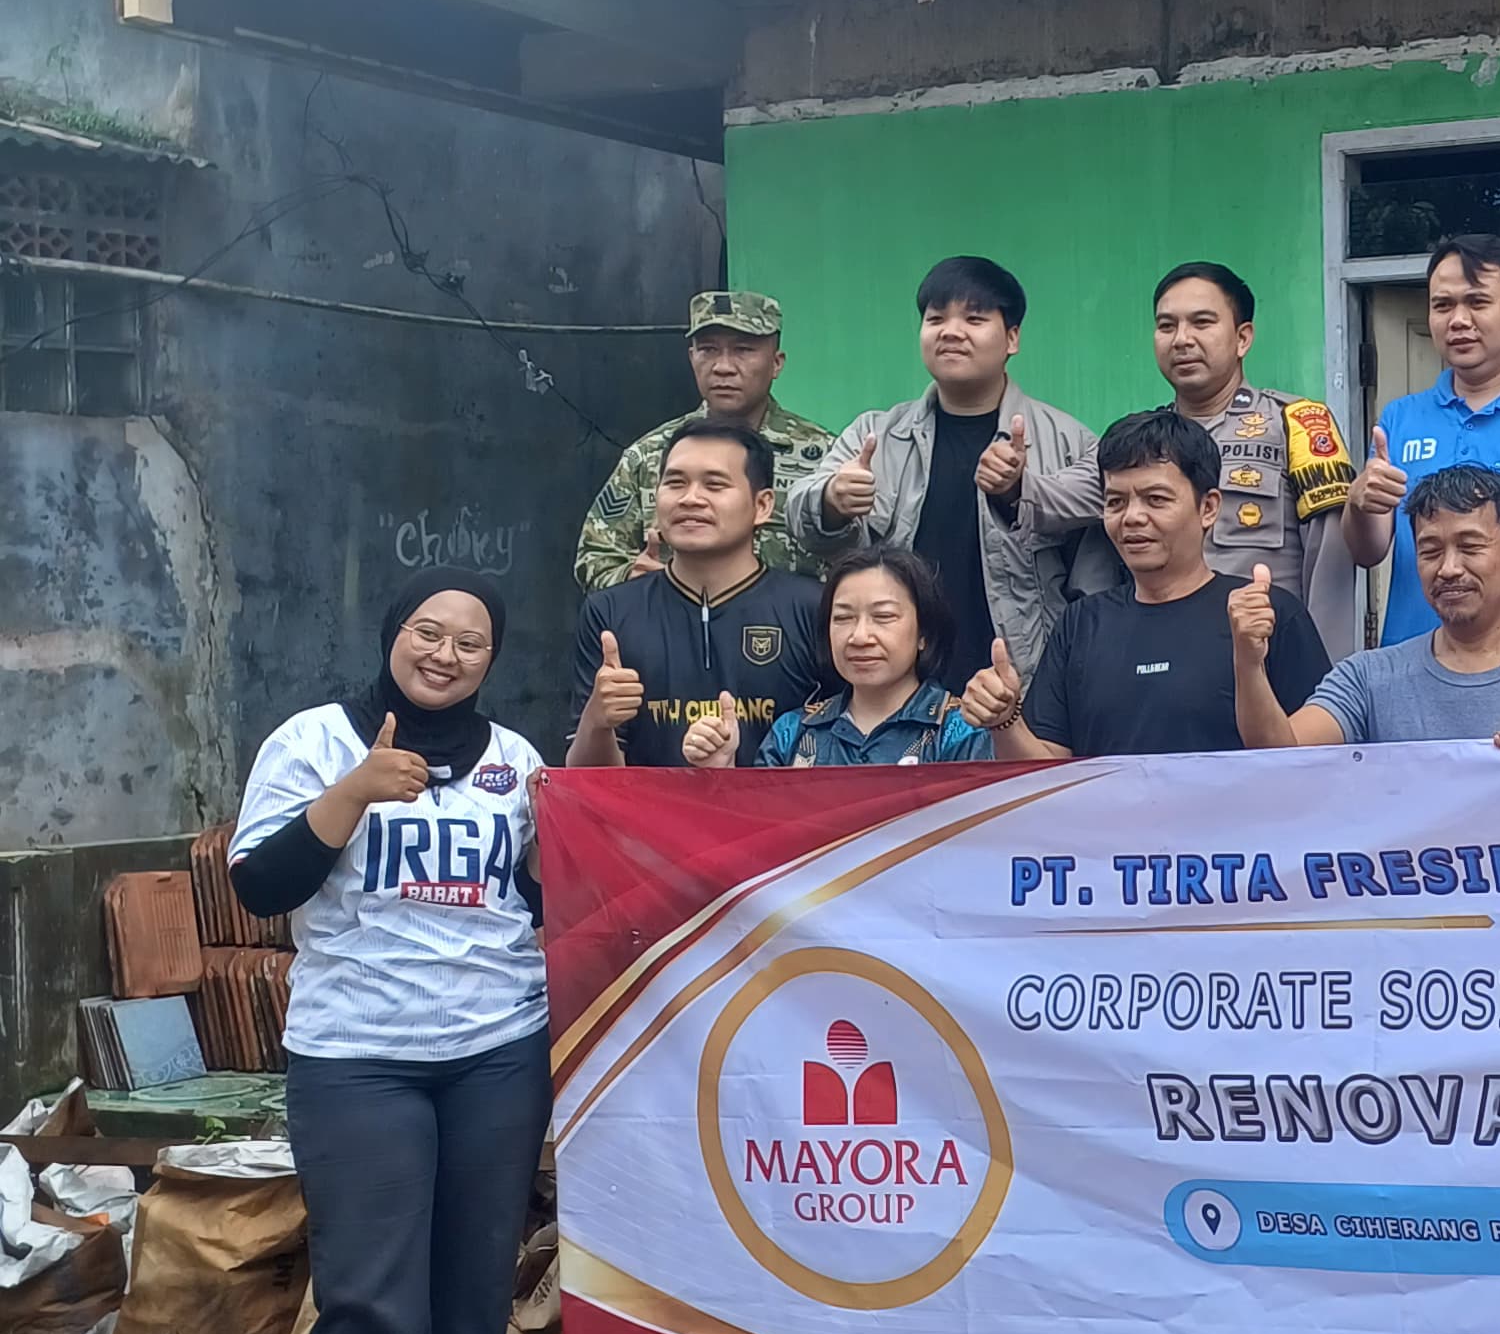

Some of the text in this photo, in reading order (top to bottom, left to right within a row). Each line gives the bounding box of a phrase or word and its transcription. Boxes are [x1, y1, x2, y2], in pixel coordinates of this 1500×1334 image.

[1221, 444, 1280, 462] POLISI
[1401, 437, 1438, 463] M3
[362, 811, 513, 900] IRGA
[1010, 855, 1094, 907] PT.
[1113, 853, 1288, 906] TIRTA
[1006, 971, 1353, 1032] CORPORATE
[743, 1138, 969, 1186] MAYORA
[793, 1192, 916, 1224] GROUP
[1256, 1210, 1328, 1236] DESA
[1333, 1215, 1482, 1242] CIHERANG
